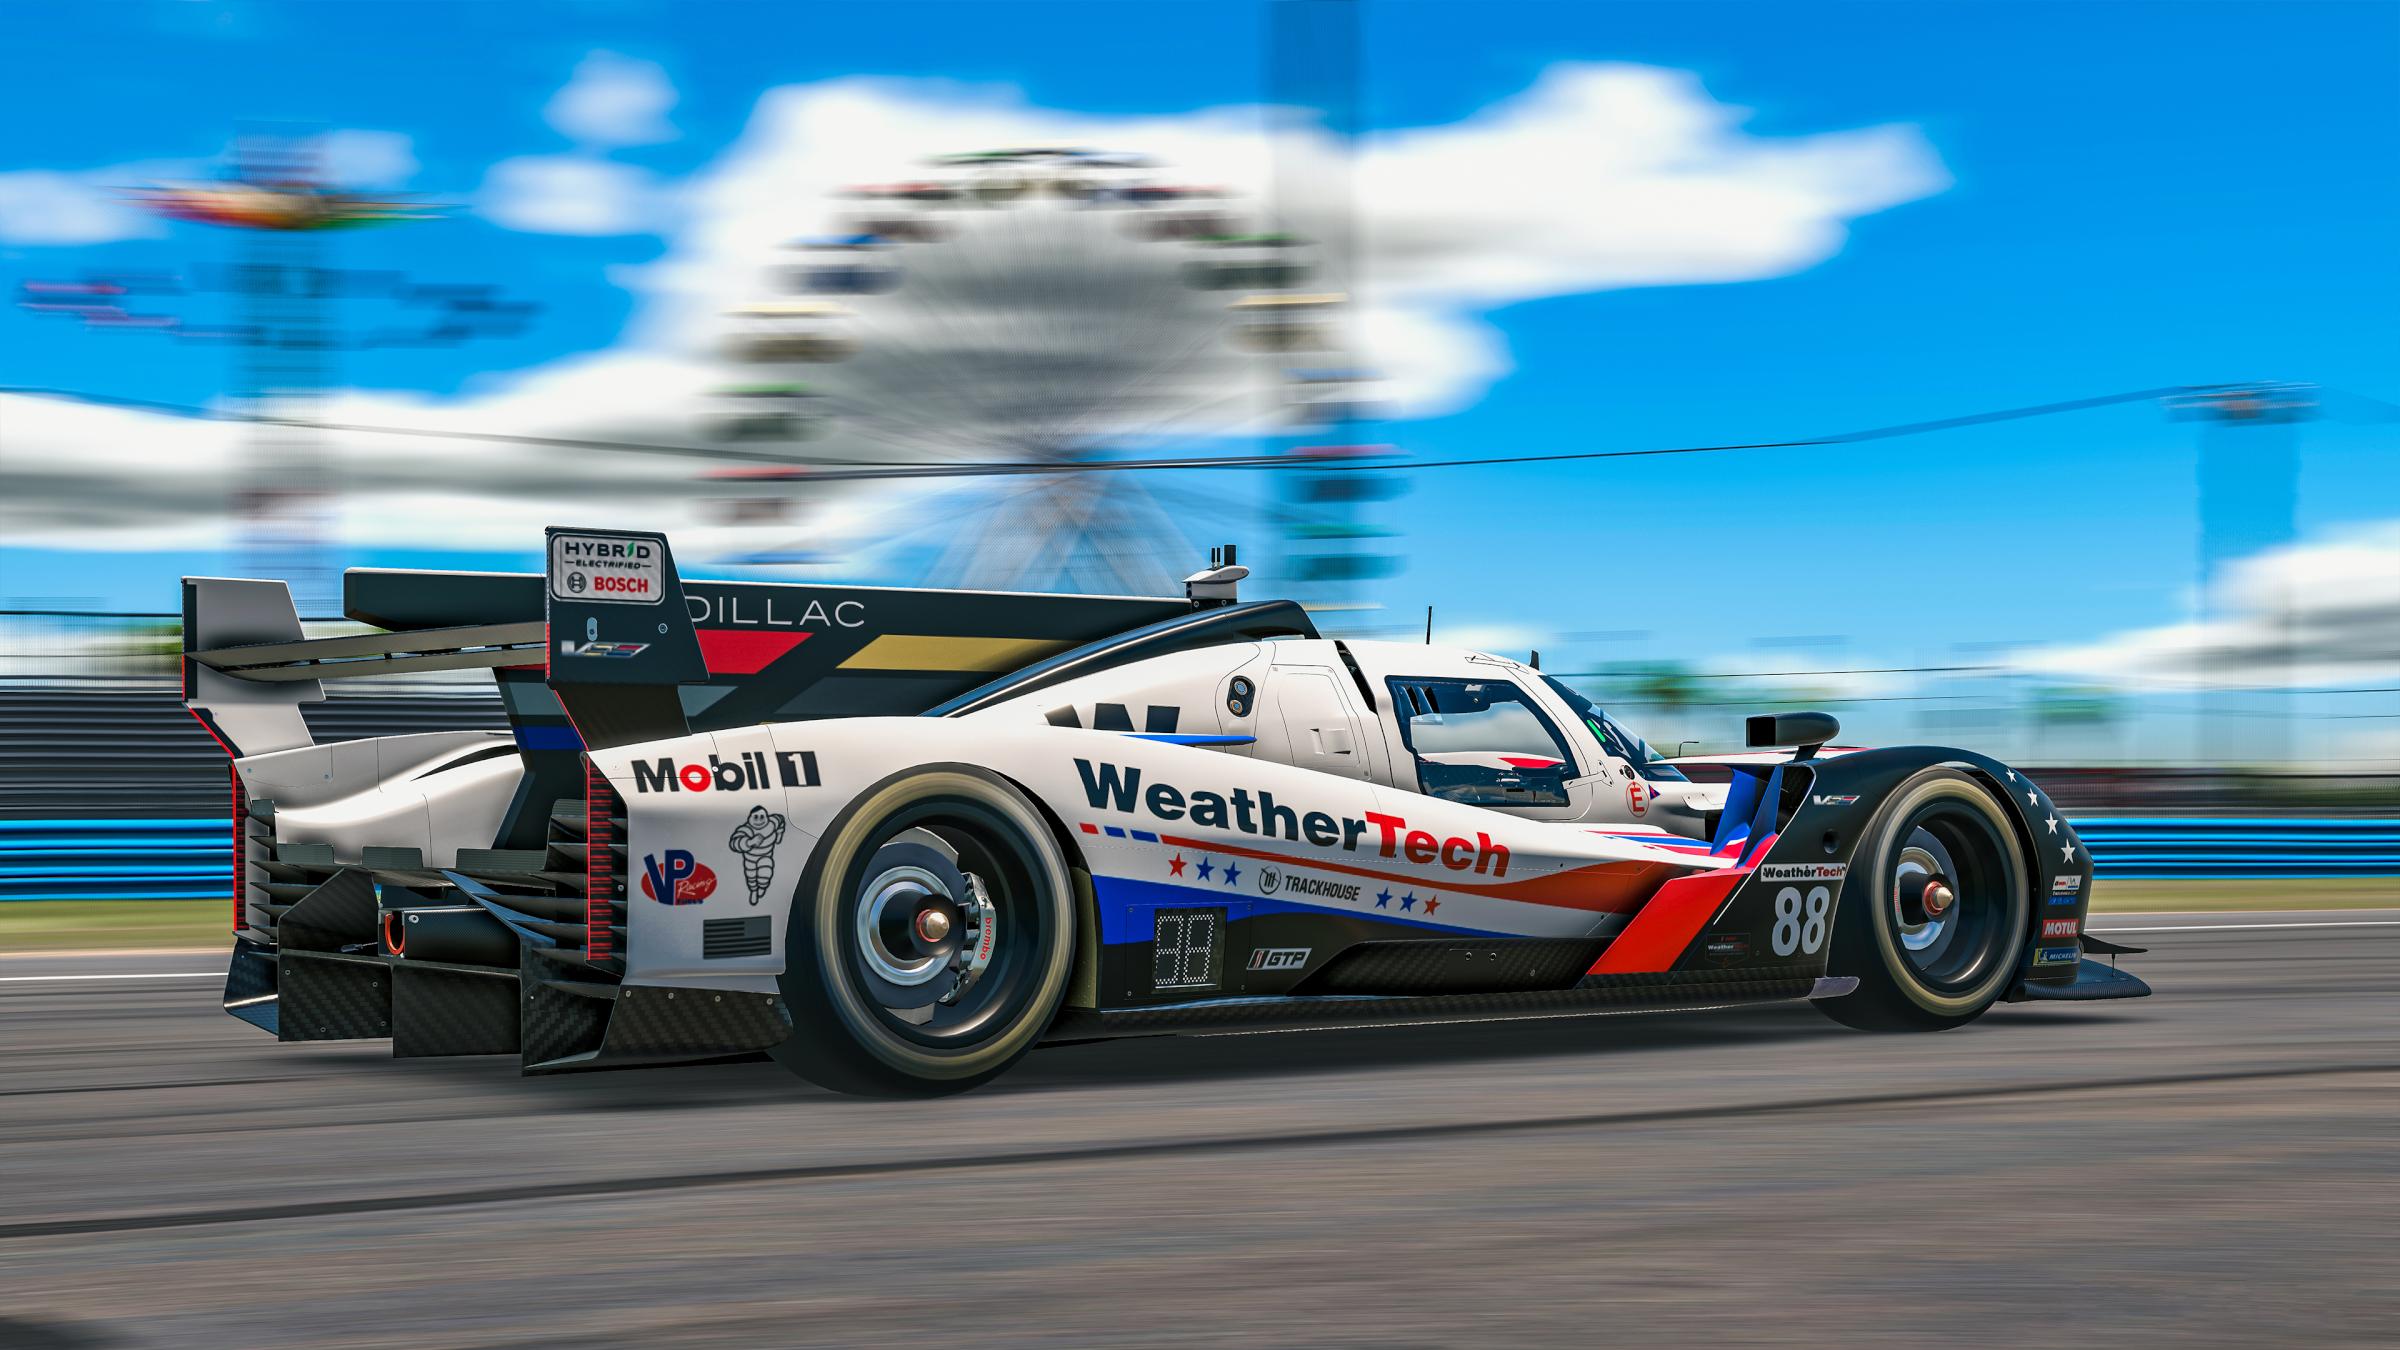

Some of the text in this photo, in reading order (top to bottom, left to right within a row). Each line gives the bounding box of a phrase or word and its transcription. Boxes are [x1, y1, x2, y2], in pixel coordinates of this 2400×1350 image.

[564, 541, 651, 558] HYBRID
[575, 560, 641, 569] ELECTRIFIED
[594, 576, 649, 593] BOSCH
[631, 751, 813, 793] Mobil 1
[1630, 788, 1645, 812] E
[1073, 757, 1512, 878] WeatherTech
[643, 849, 695, 906] VP
[1763, 866, 1844, 879] WeatherTech
[677, 878, 716, 899] Racing
[1284, 875, 1361, 902] TRACKHOUSE
[1771, 886, 1830, 957] 88
[2045, 922, 2077, 935] MOTUL
[980, 917, 993, 961] brembo
[1266, 951, 1306, 966] GTP
